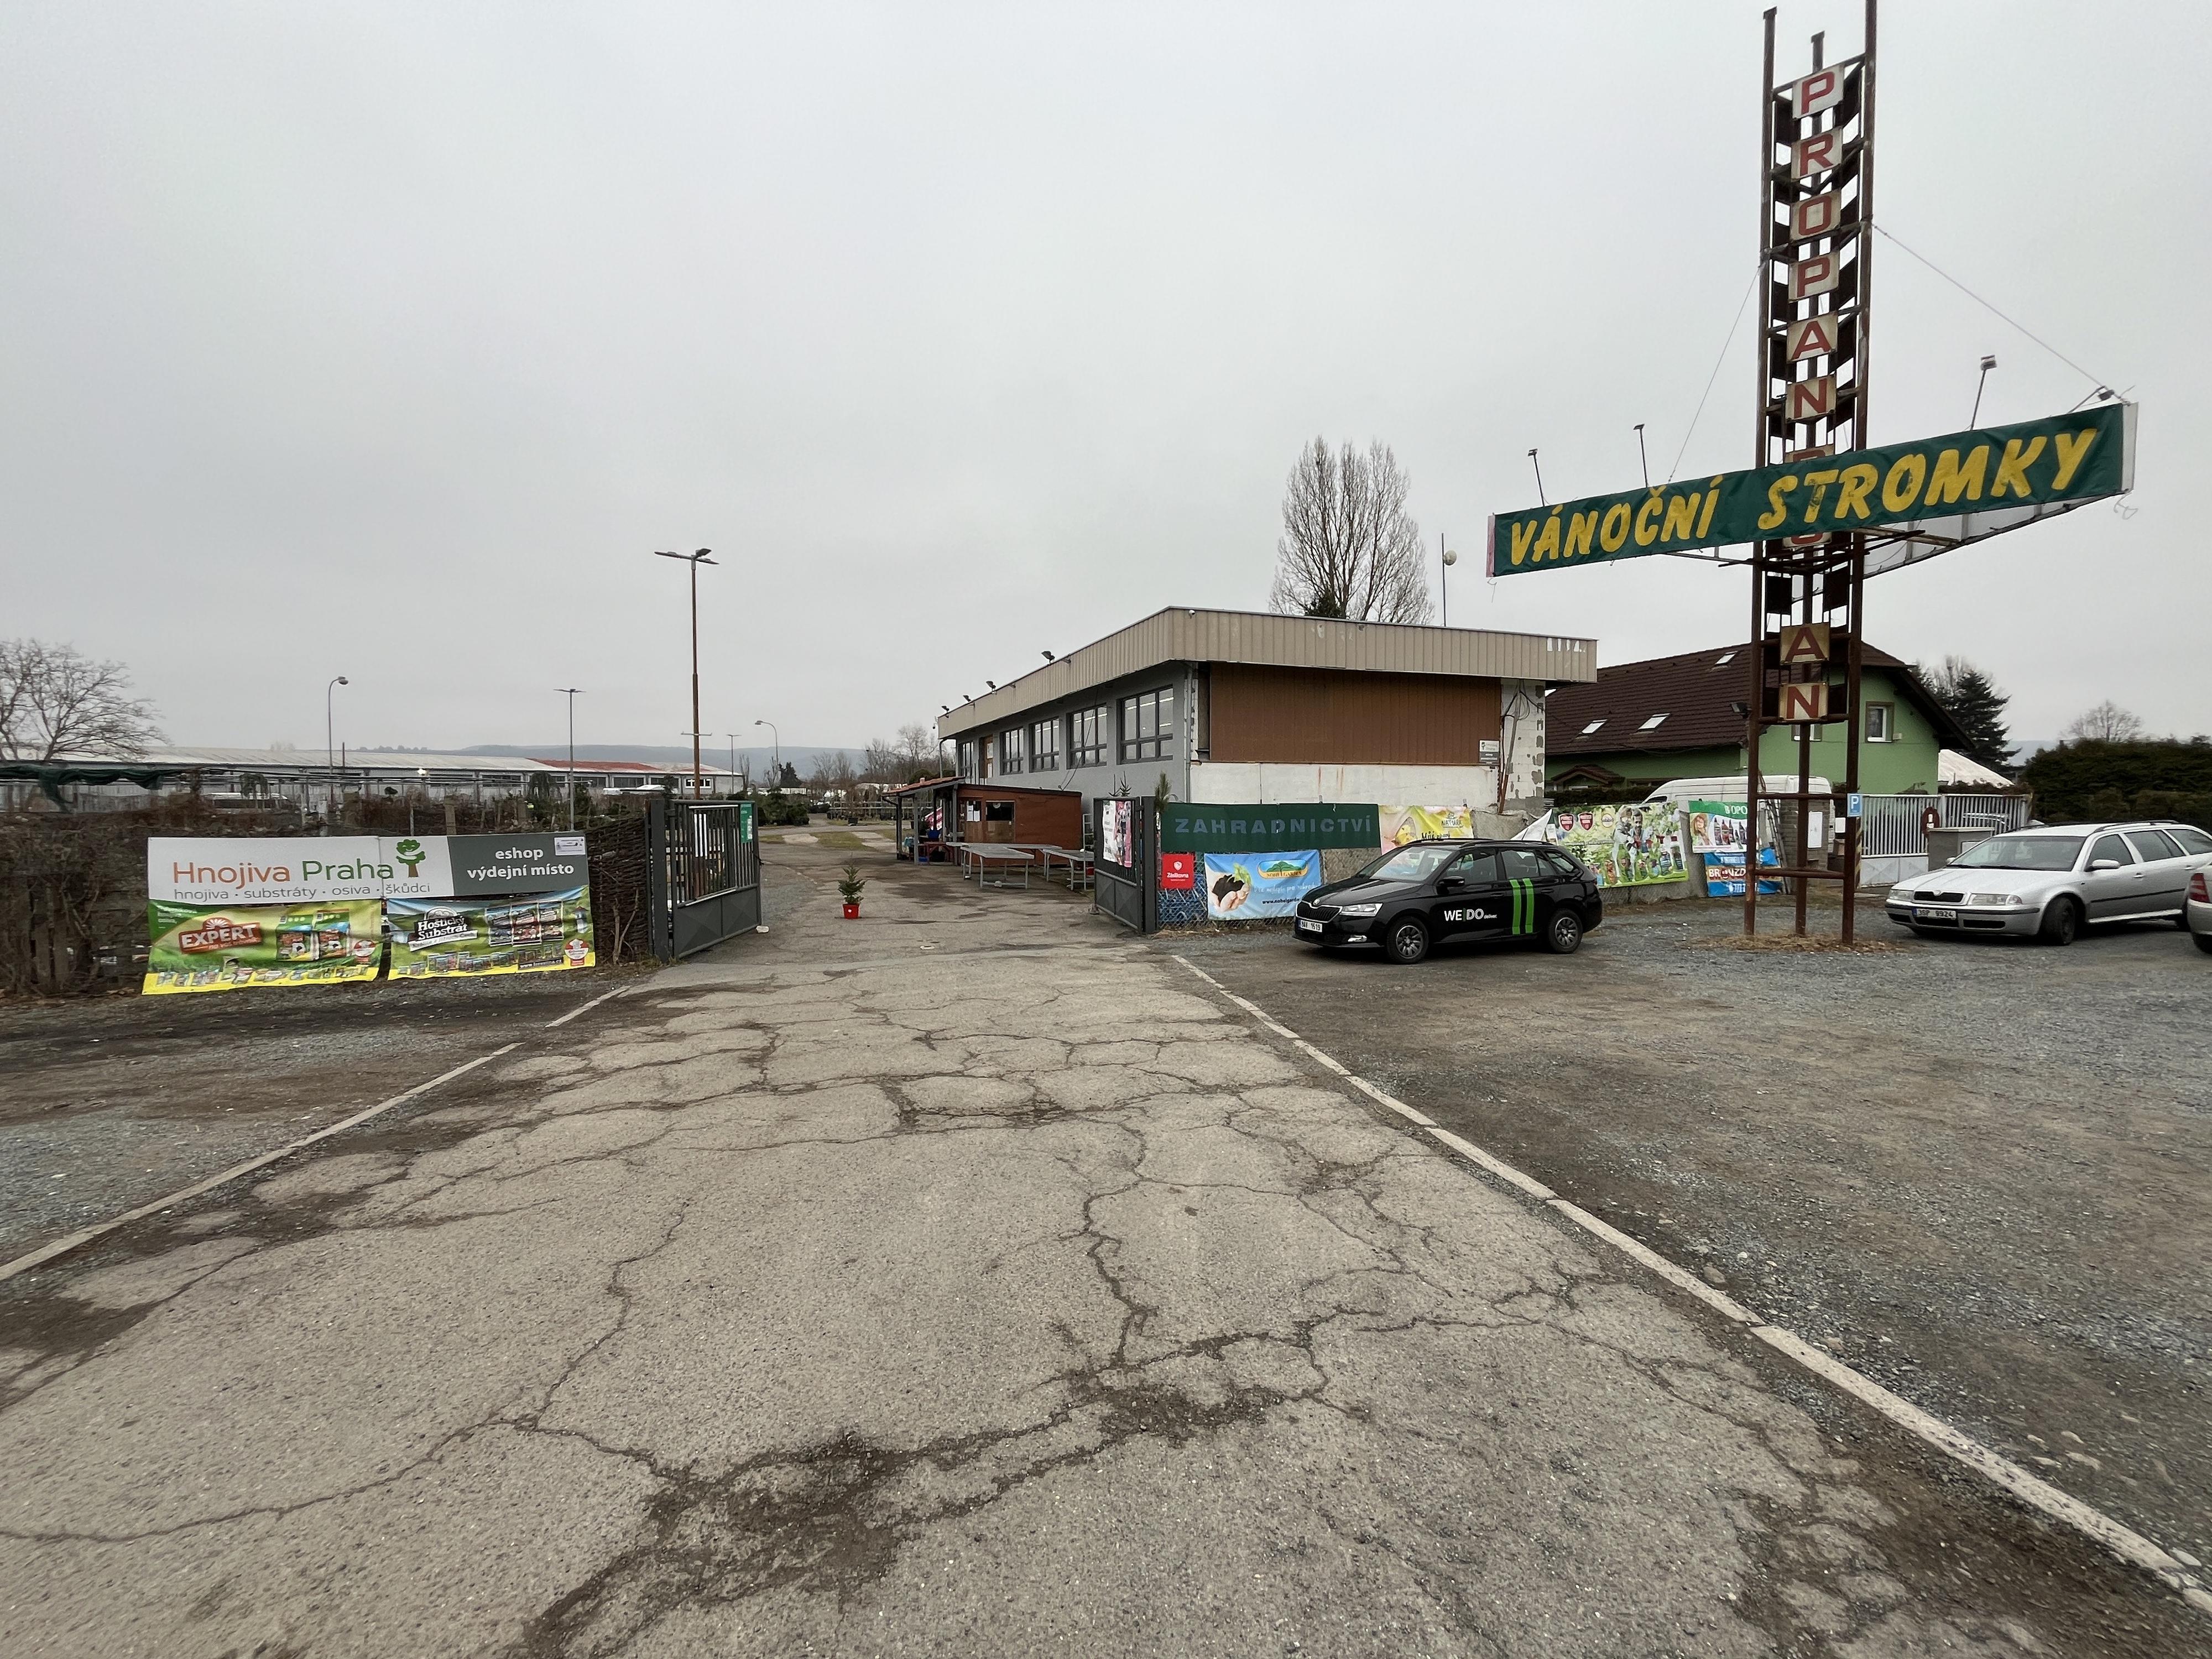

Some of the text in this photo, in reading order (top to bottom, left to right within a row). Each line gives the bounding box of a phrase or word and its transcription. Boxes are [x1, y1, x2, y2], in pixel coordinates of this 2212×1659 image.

[1792, 70, 1835, 419] PROPAN
[1511, 427, 2098, 566] VÁNOČNÍ STROMKY
[1175, 815, 1371, 834] ZAHRADNICTVÍ
[495, 847, 544, 861] eshop
[173, 858, 394, 889] Hnojiva Praha
[467, 863, 575, 881] výdejní místo
[174, 883, 431, 902] hnojiva substráty osiva škůdci
[181, 924, 257, 948] EXPERT
[418, 923, 468, 940] Substrát
